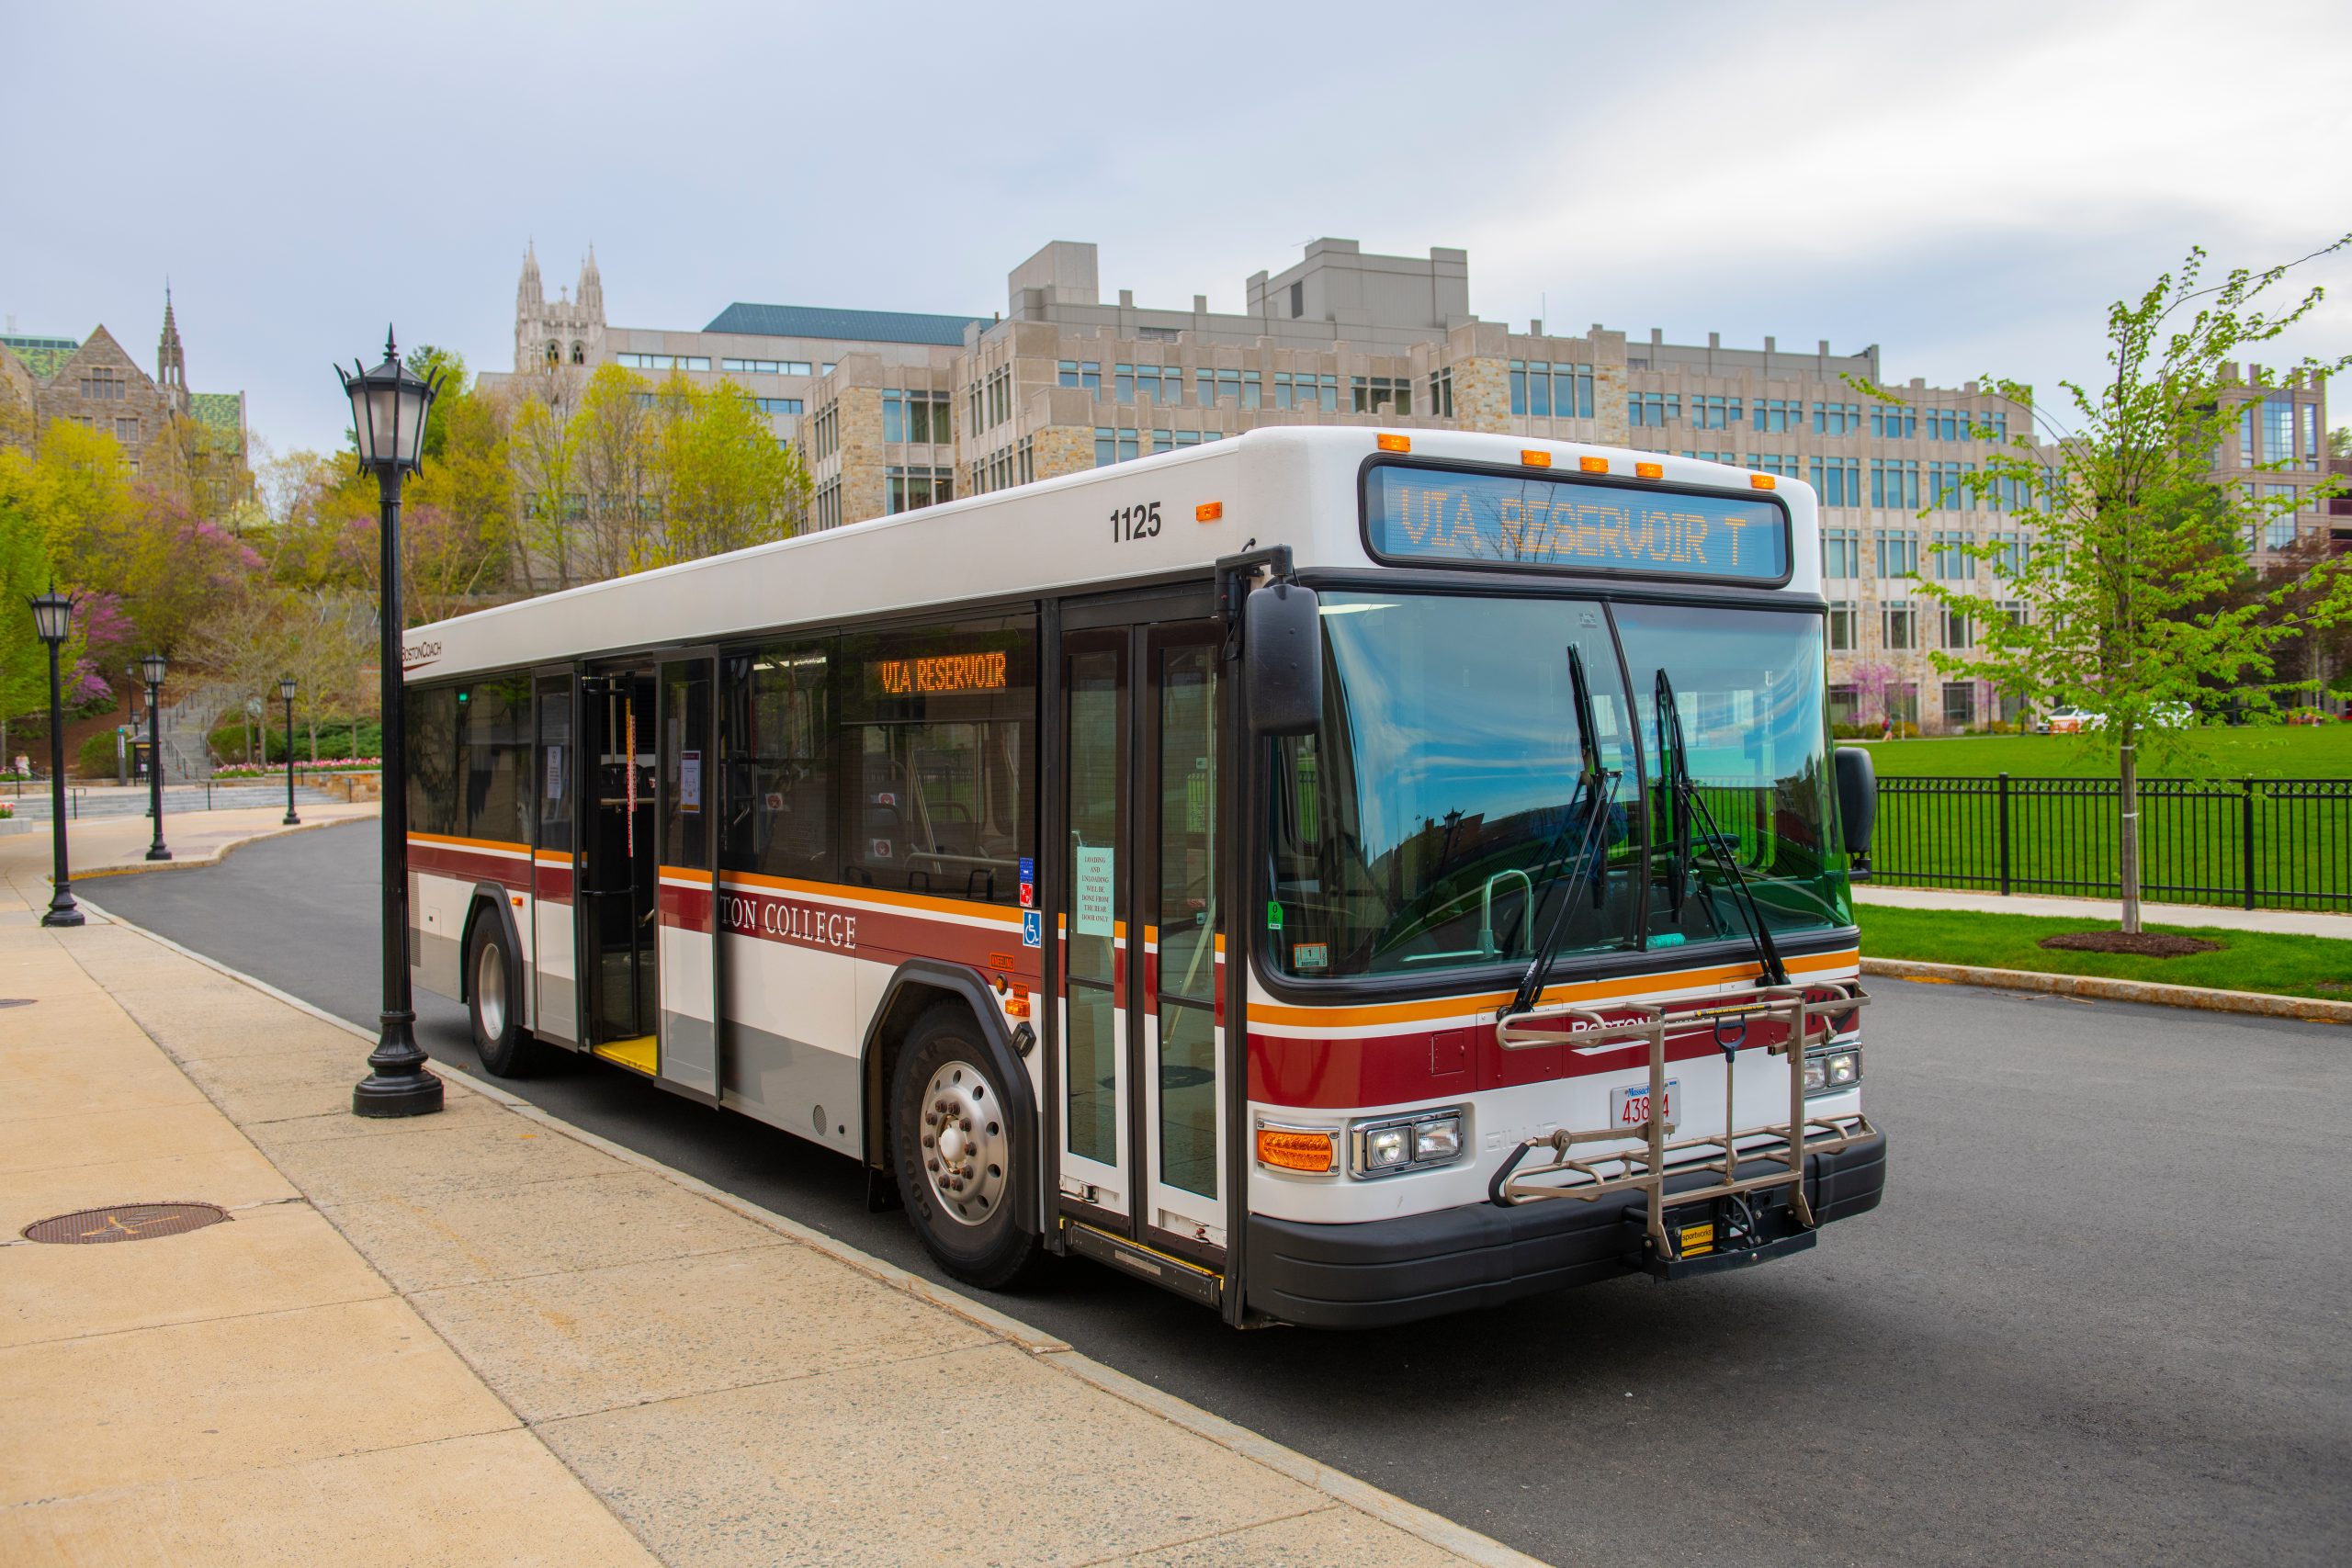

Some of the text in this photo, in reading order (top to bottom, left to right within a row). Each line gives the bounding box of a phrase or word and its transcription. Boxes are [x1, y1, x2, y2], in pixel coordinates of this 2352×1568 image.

[1110, 501, 1161, 543] 1125
[1401, 490, 1747, 565] VIA RESERVOIR T
[883, 653, 1006, 694] VIA RESERVOIR
[764, 903, 856, 950] COLLEGE
[1623, 1093, 1669, 1124] 4384
[1682, 1229, 1712, 1242] sportworks
